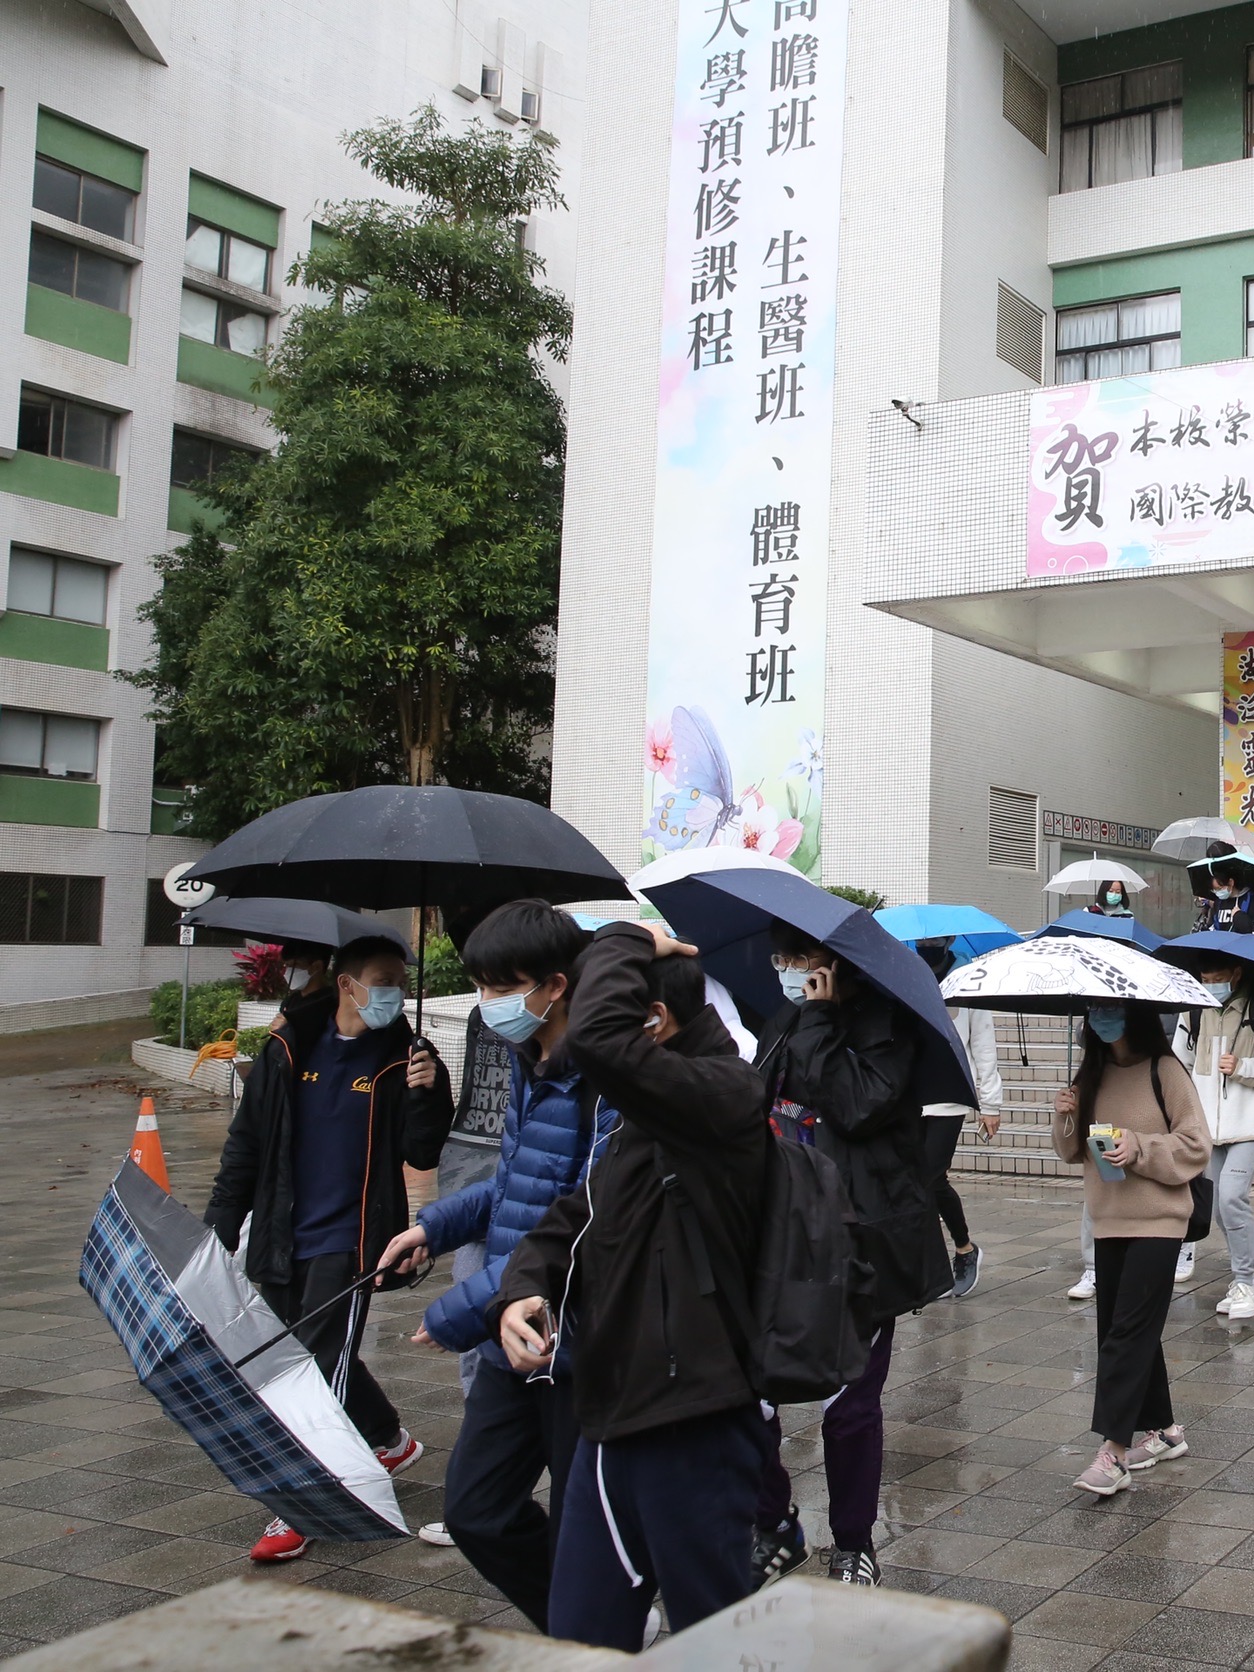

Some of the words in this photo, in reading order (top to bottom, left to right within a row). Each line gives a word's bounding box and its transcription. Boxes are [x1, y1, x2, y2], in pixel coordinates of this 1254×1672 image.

[687, 0, 749, 371] 大學預修課程
[1045, 423, 1118, 531] 賀
[174, 879, 203, 892] 20
